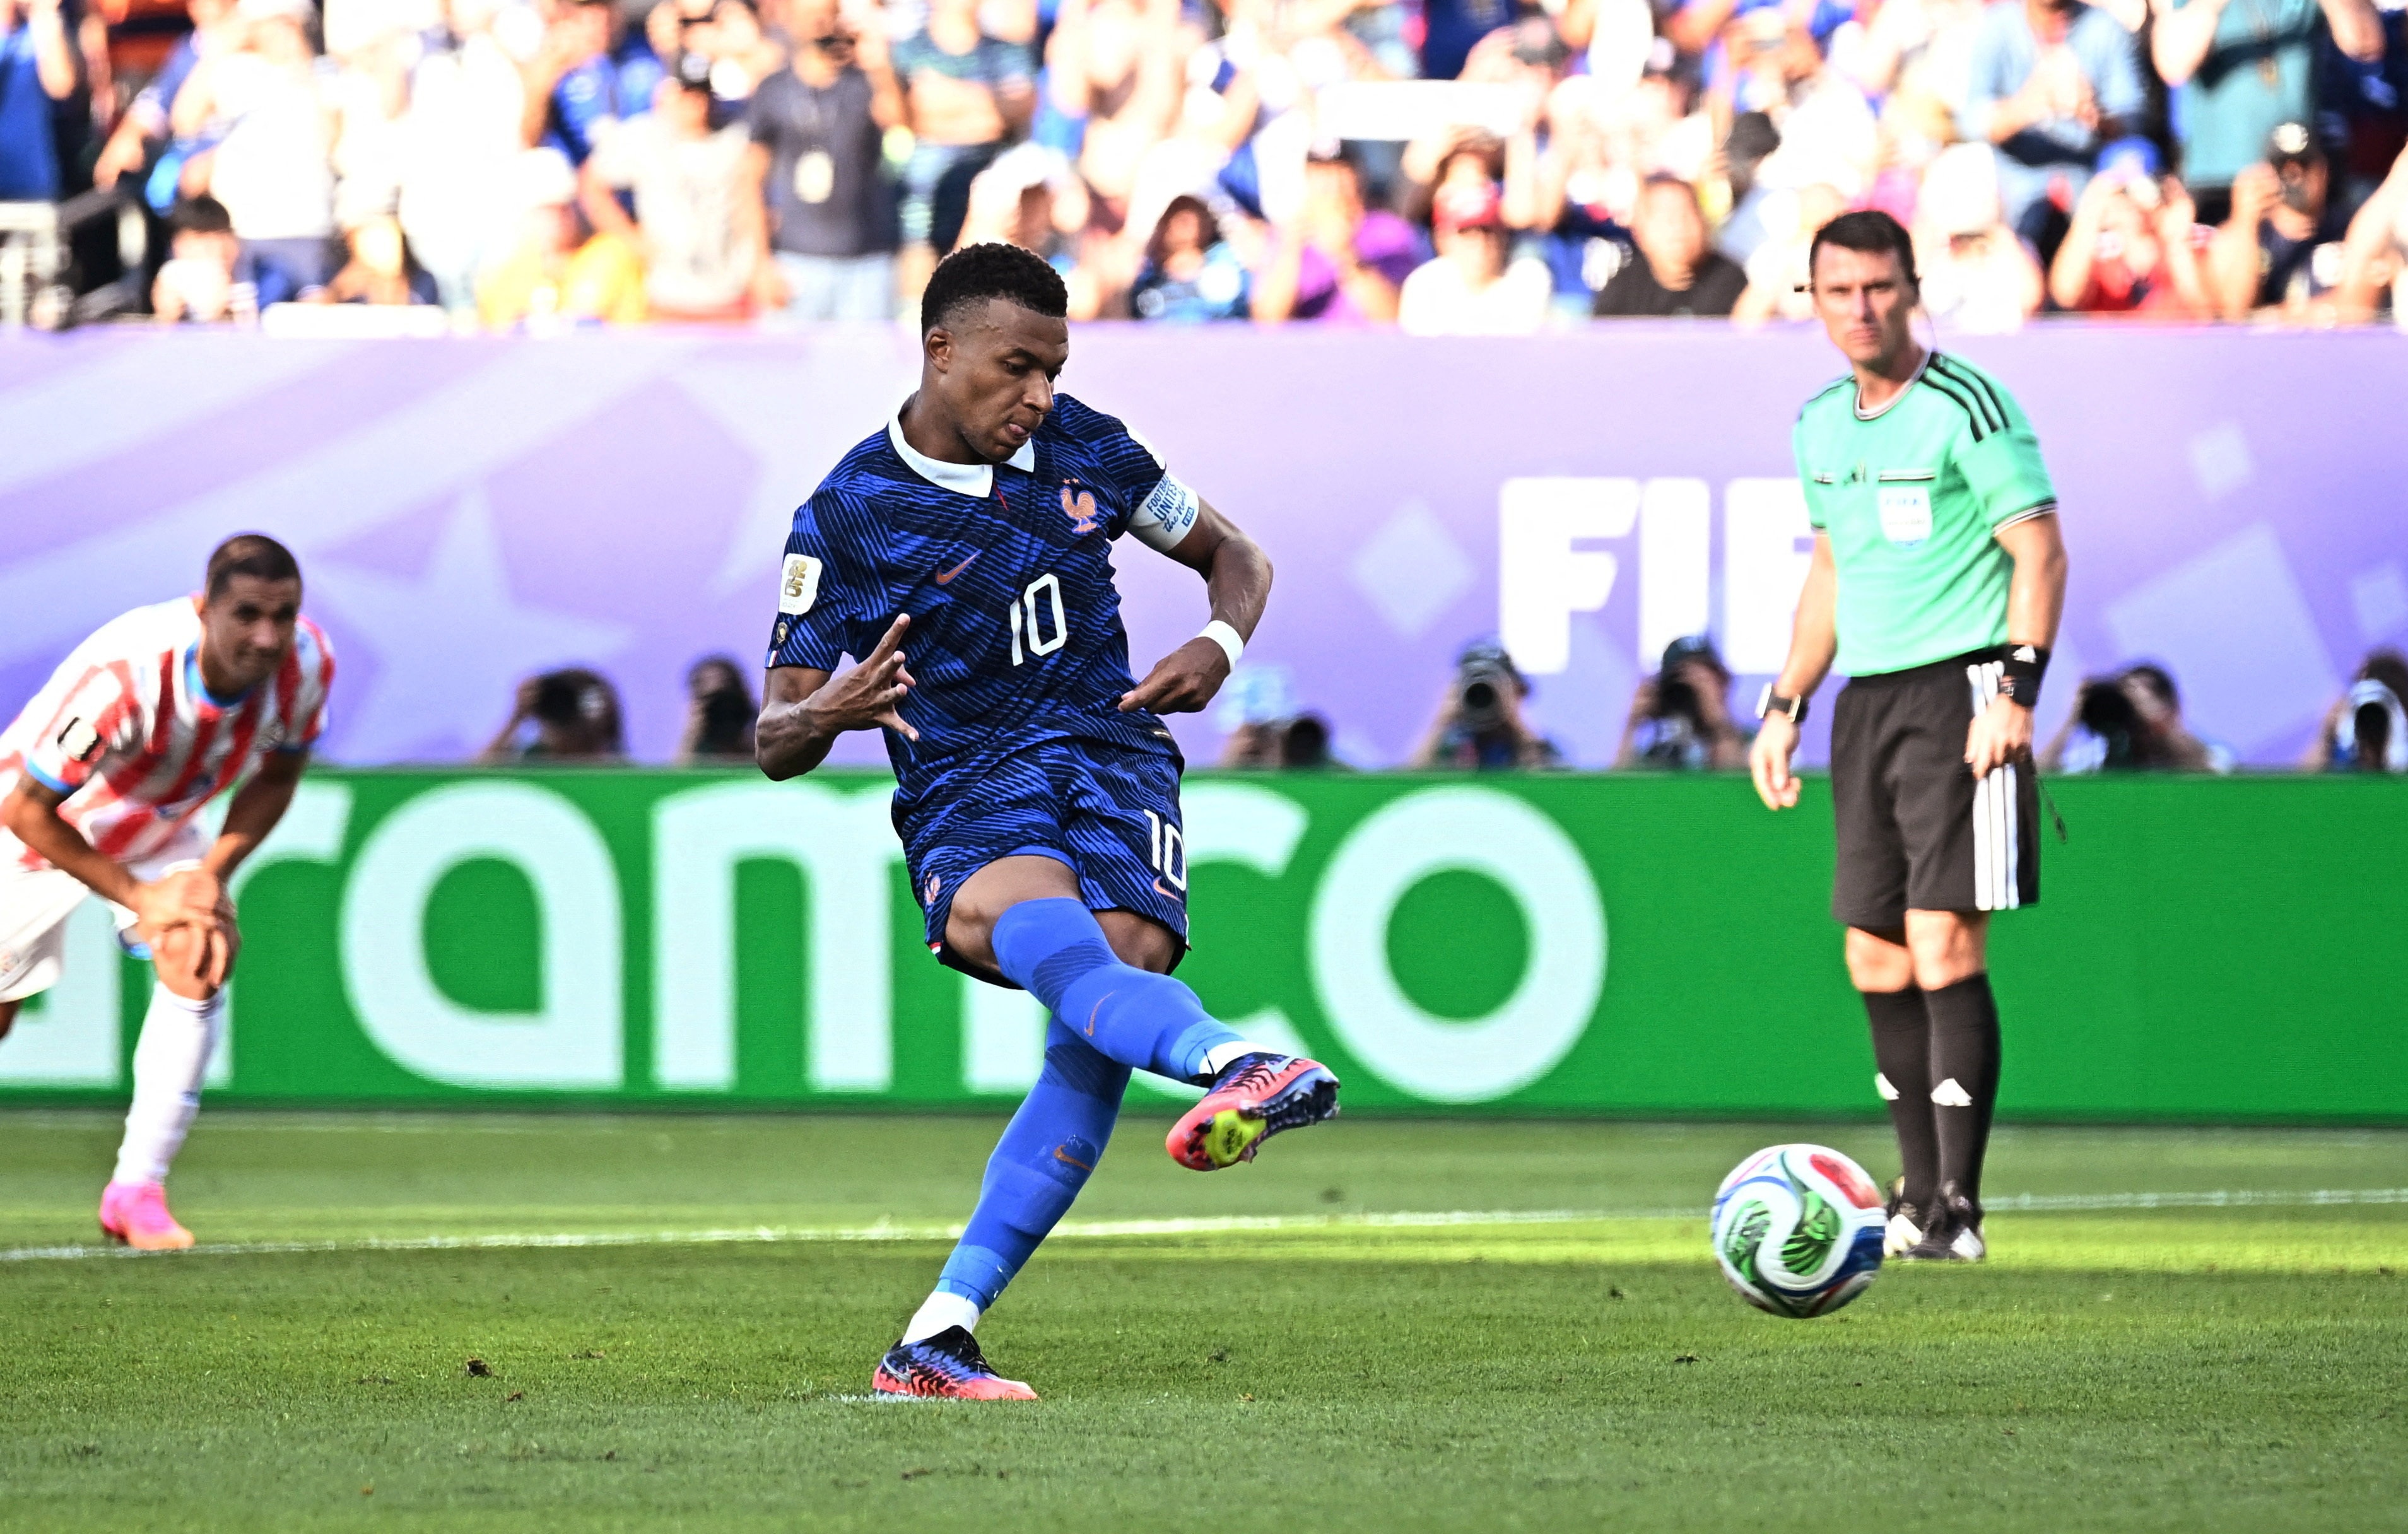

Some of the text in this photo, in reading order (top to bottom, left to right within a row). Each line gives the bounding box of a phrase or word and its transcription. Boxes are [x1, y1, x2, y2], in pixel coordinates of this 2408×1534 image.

[1153, 480, 1177, 521] UNITES
[1163, 515, 1179, 532] the
[1499, 477, 1813, 674] FIF
[1009, 573, 1067, 666] 10
[1143, 809, 1187, 891] 10
[0, 780, 1607, 1101] ramo
